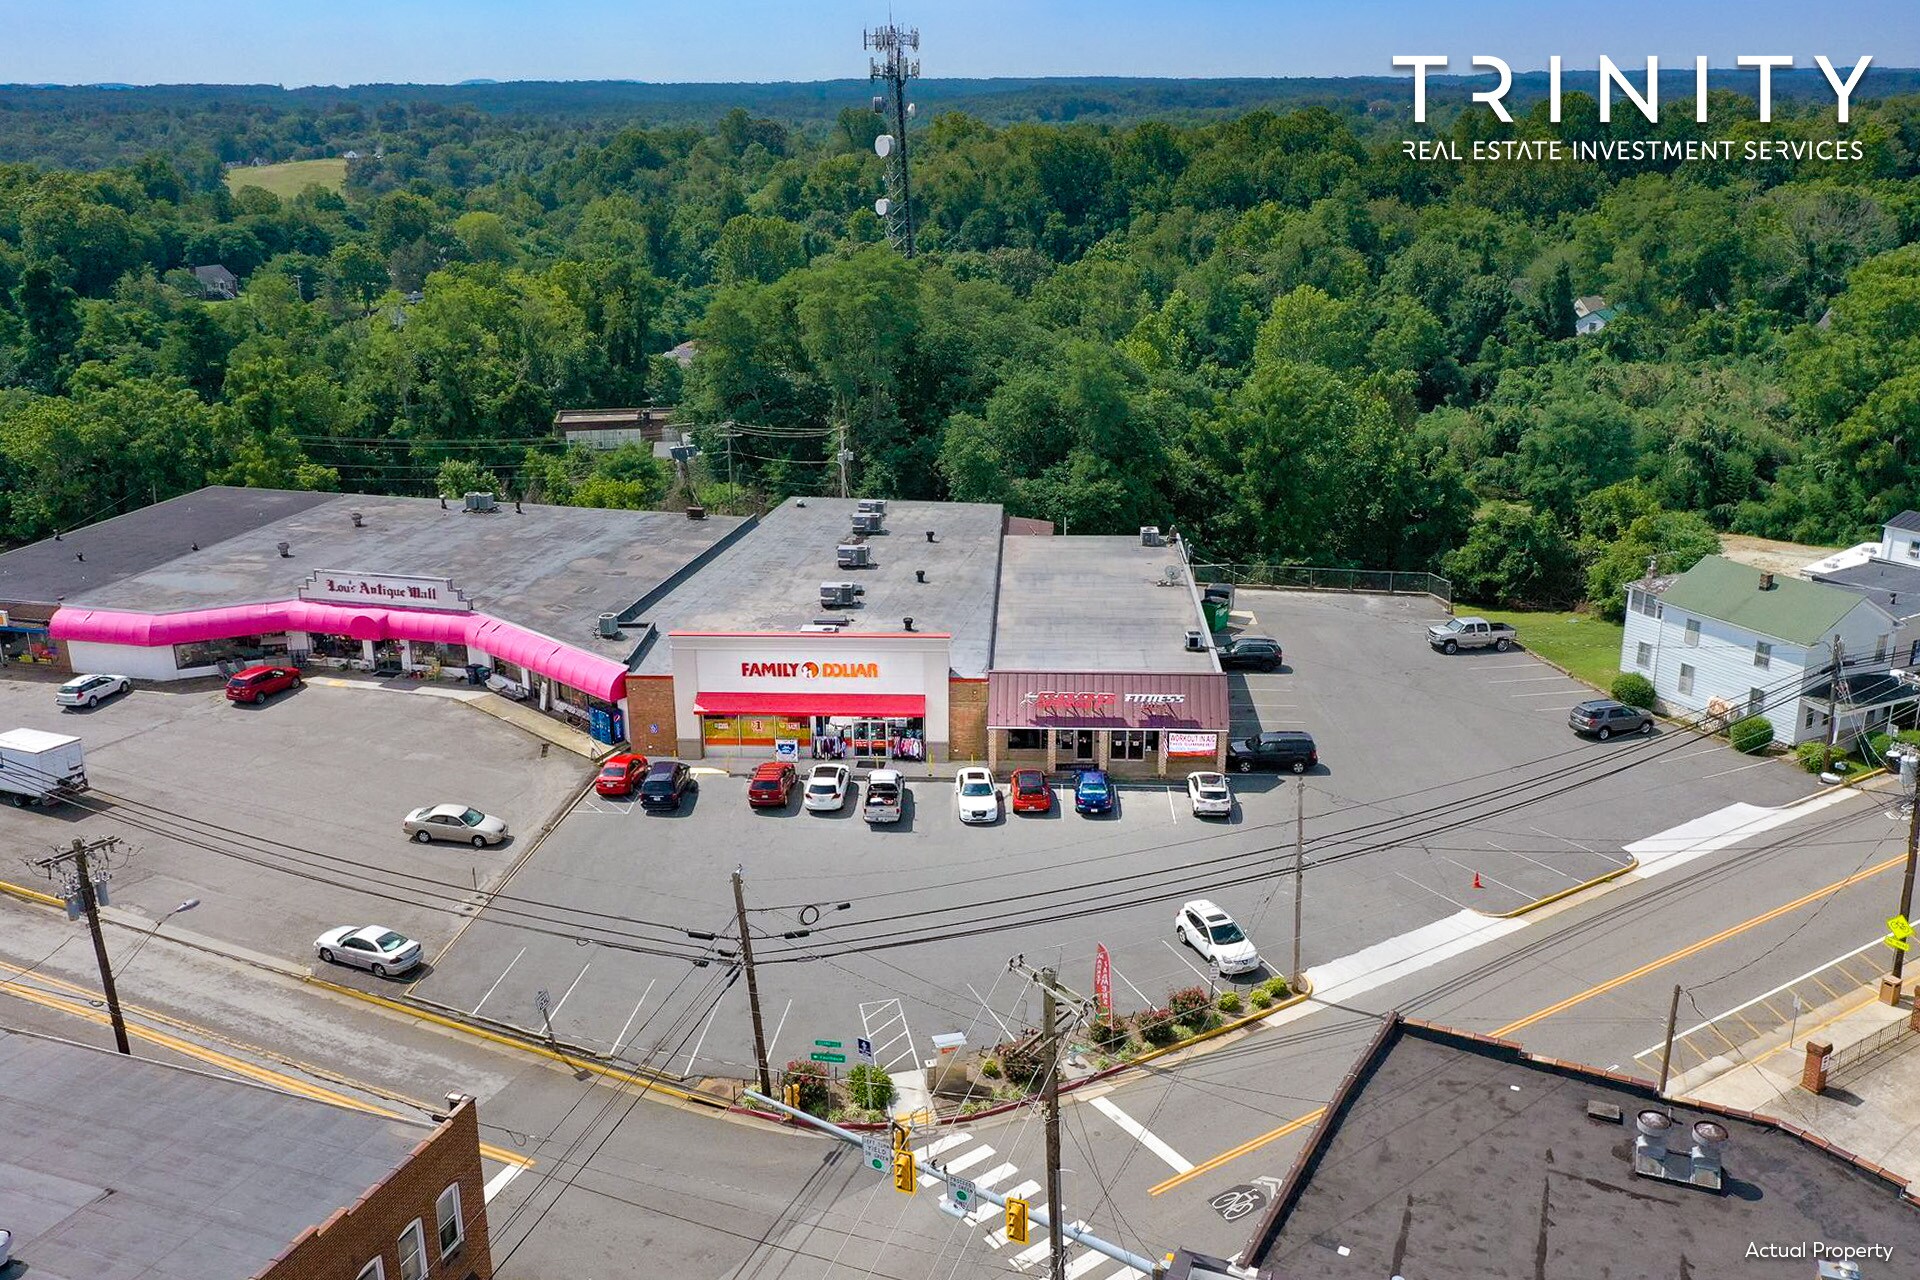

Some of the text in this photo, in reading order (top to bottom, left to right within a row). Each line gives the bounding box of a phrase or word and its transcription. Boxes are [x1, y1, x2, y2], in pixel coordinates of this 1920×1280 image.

[326, 579, 437, 600] Lou's Antique Mall
[741, 662, 879, 678] FAMILY DOLLAR
[1125, 693, 1187, 703] FITNESS
[1169, 734, 1198, 742] WORKOUT
[868, 1146, 886, 1155] YIELD
